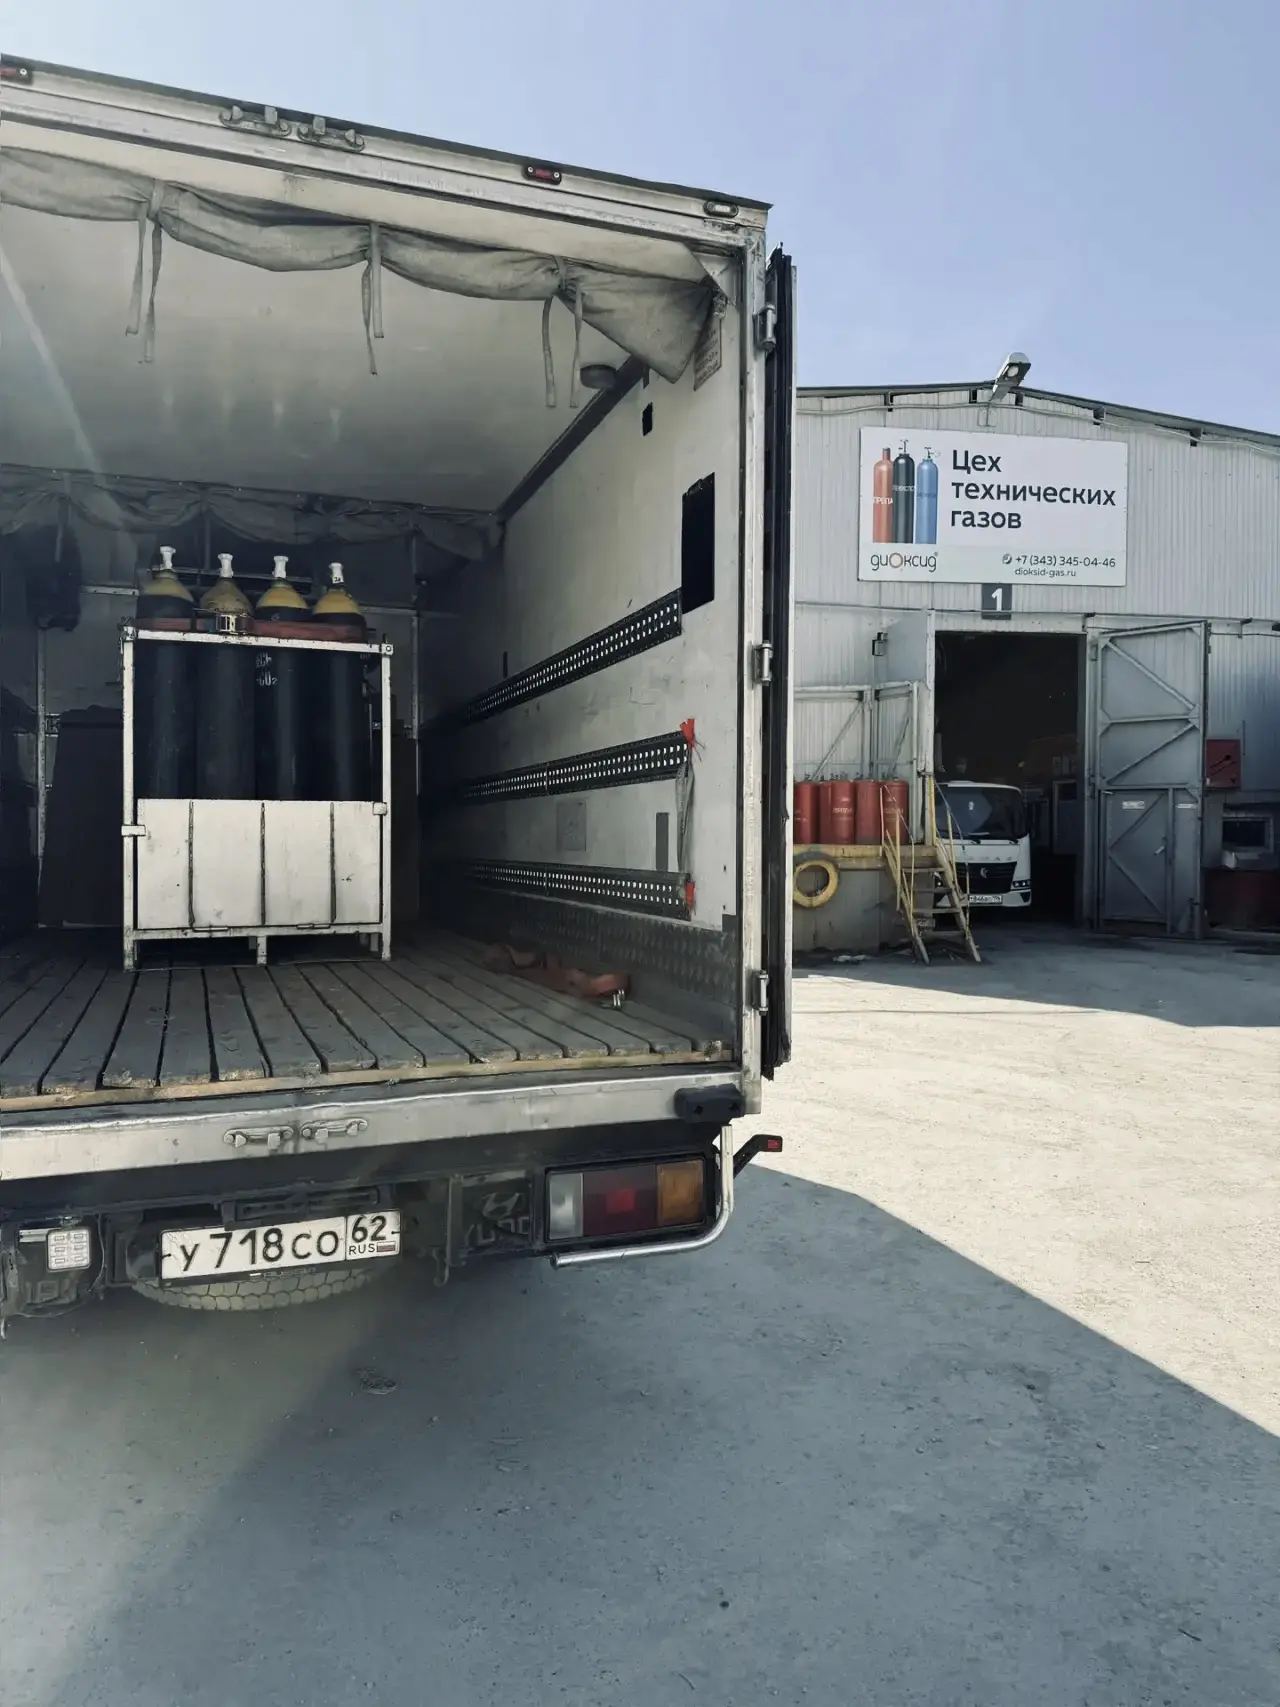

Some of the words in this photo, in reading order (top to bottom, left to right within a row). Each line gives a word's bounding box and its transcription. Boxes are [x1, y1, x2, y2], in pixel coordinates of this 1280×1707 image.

[952, 449, 1002, 475] Цех
[951, 481, 1117, 507] технических
[950, 509, 1022, 529] газов
[1015, 555, 1028, 566] +7
[1029, 554, 1057, 567] (343)
[1059, 555, 1117, 568] 345-04-46
[1014, 567, 1077, 579] dioksid-gas.ru
[991, 587, 1003, 611] 1
[350, 1214, 387, 1243] 62
[348, 1242, 376, 1256] RUS
